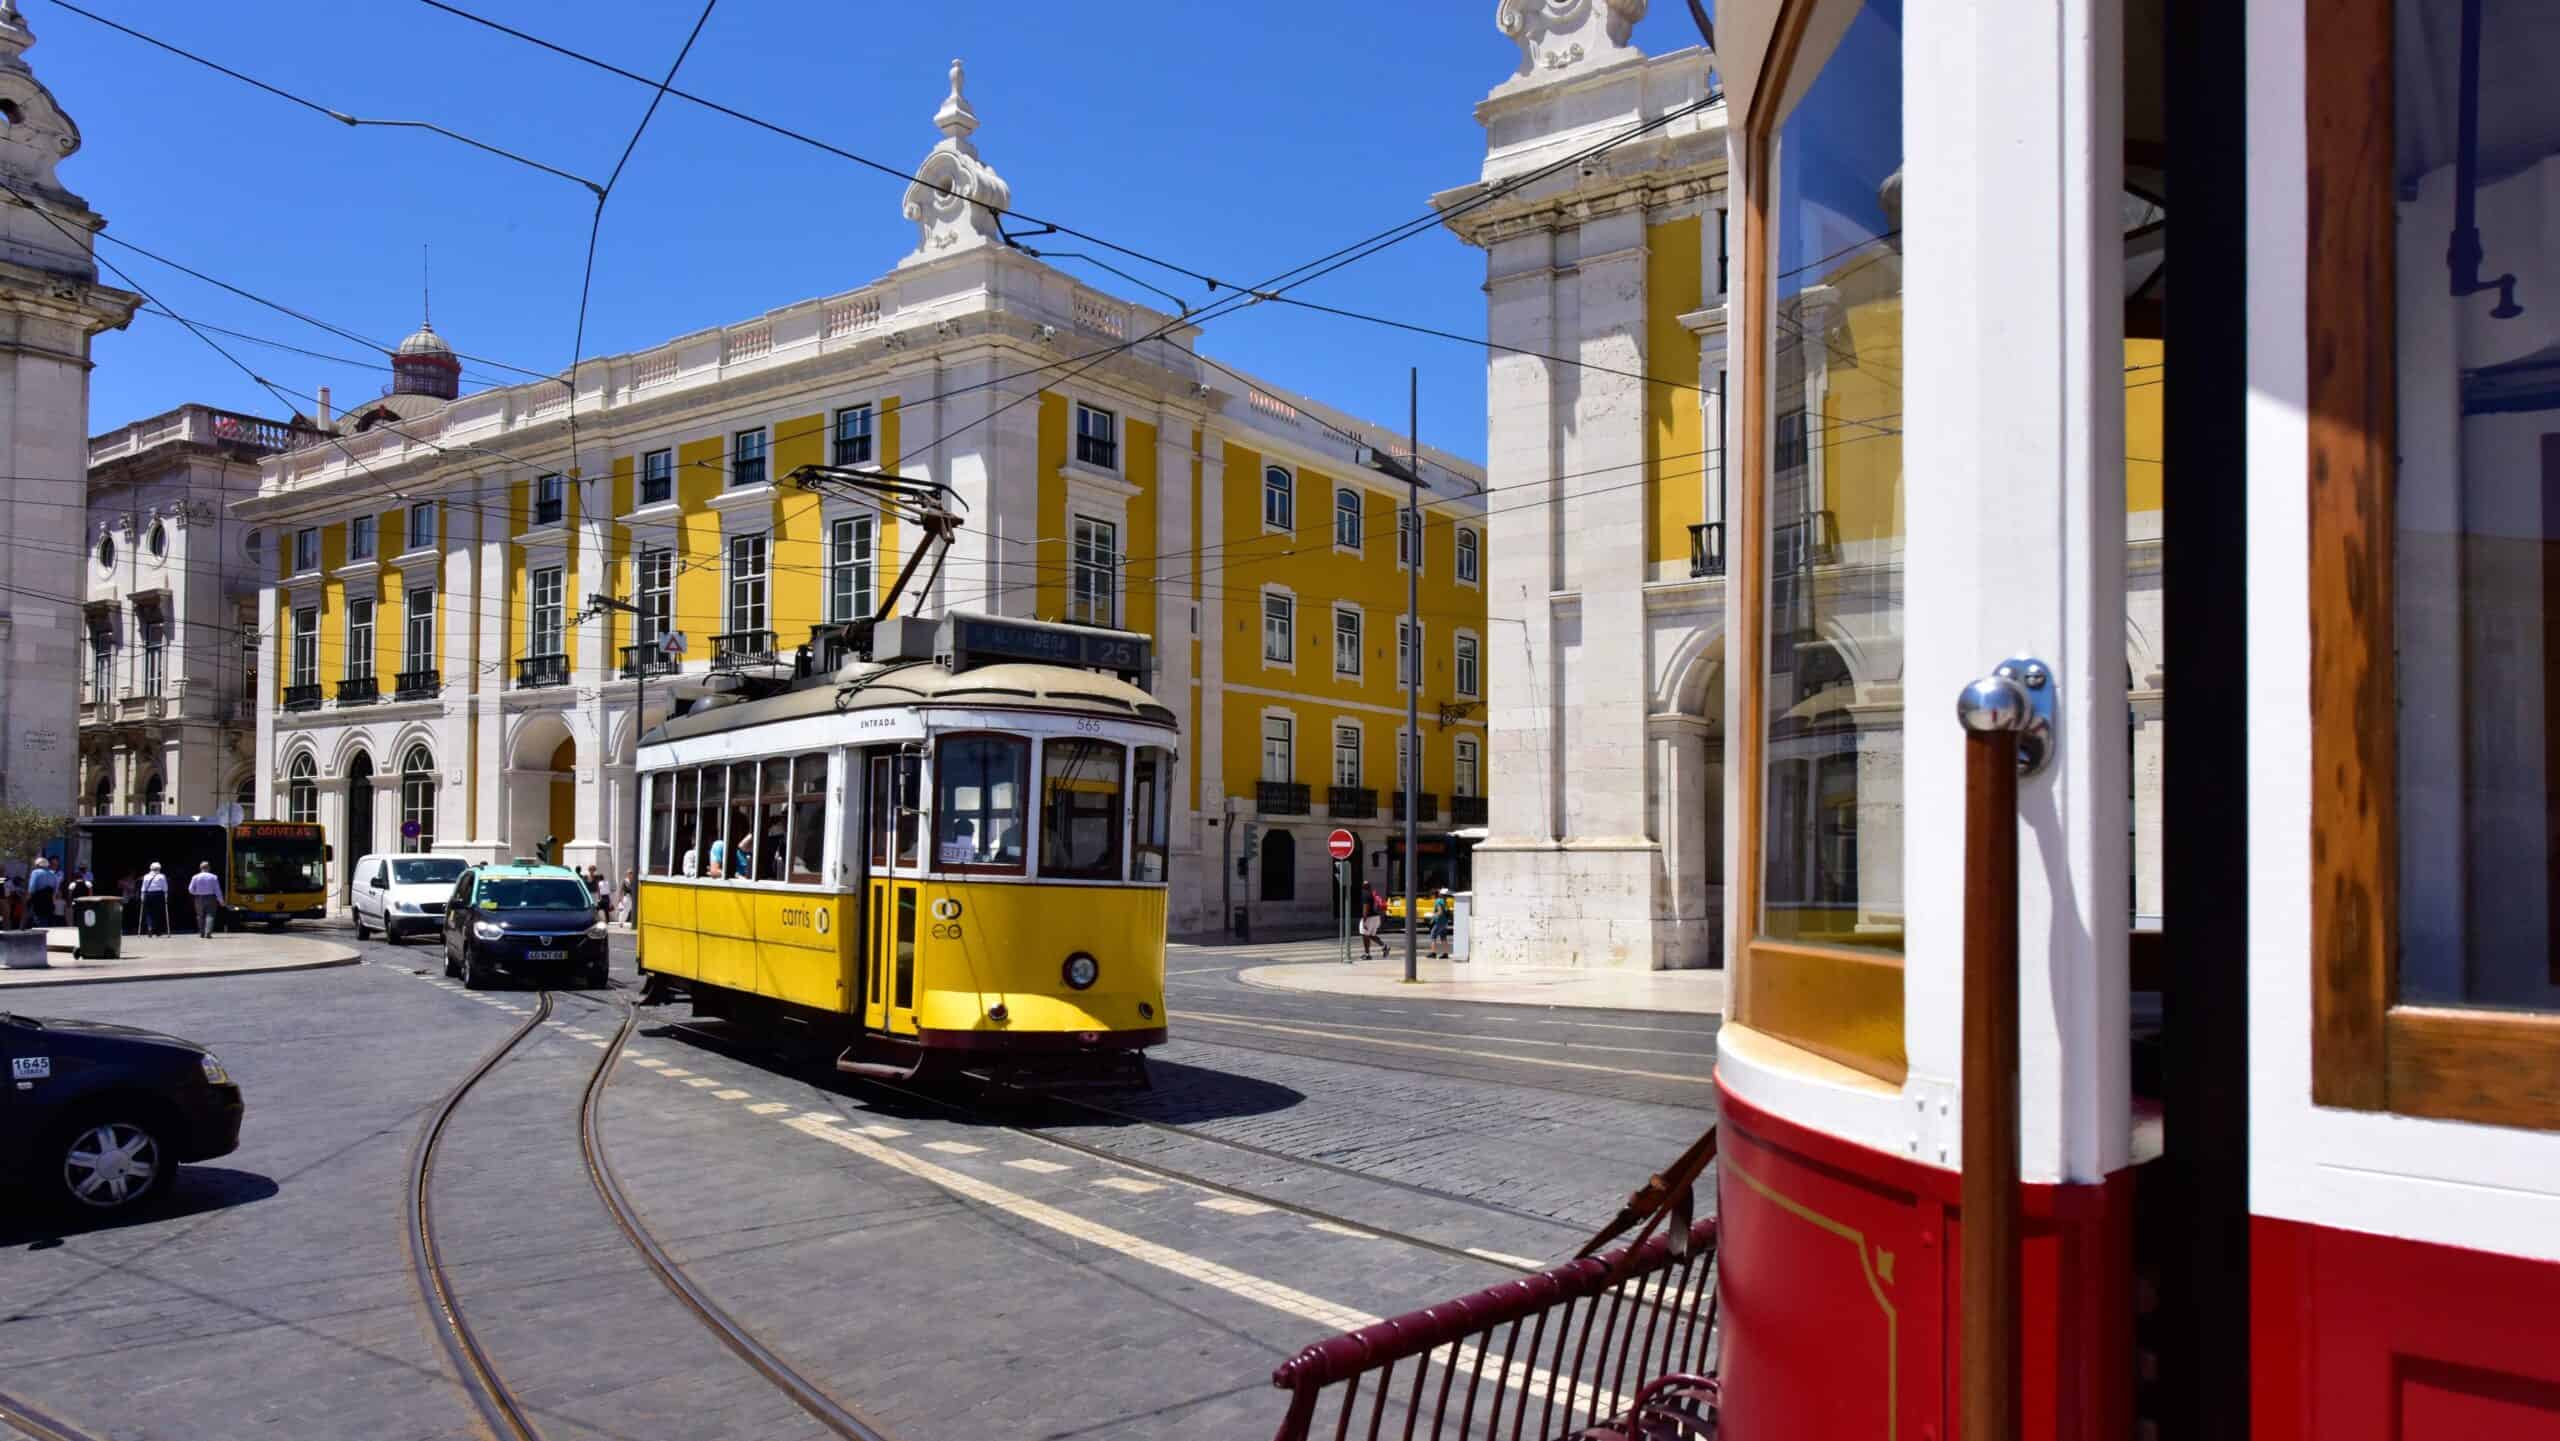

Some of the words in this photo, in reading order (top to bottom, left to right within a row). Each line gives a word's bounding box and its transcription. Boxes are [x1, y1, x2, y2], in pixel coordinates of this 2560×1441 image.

[1101, 641, 1131, 663] 25
[1077, 719, 1101, 732] 565
[14, 1058, 48, 1069] 1645
